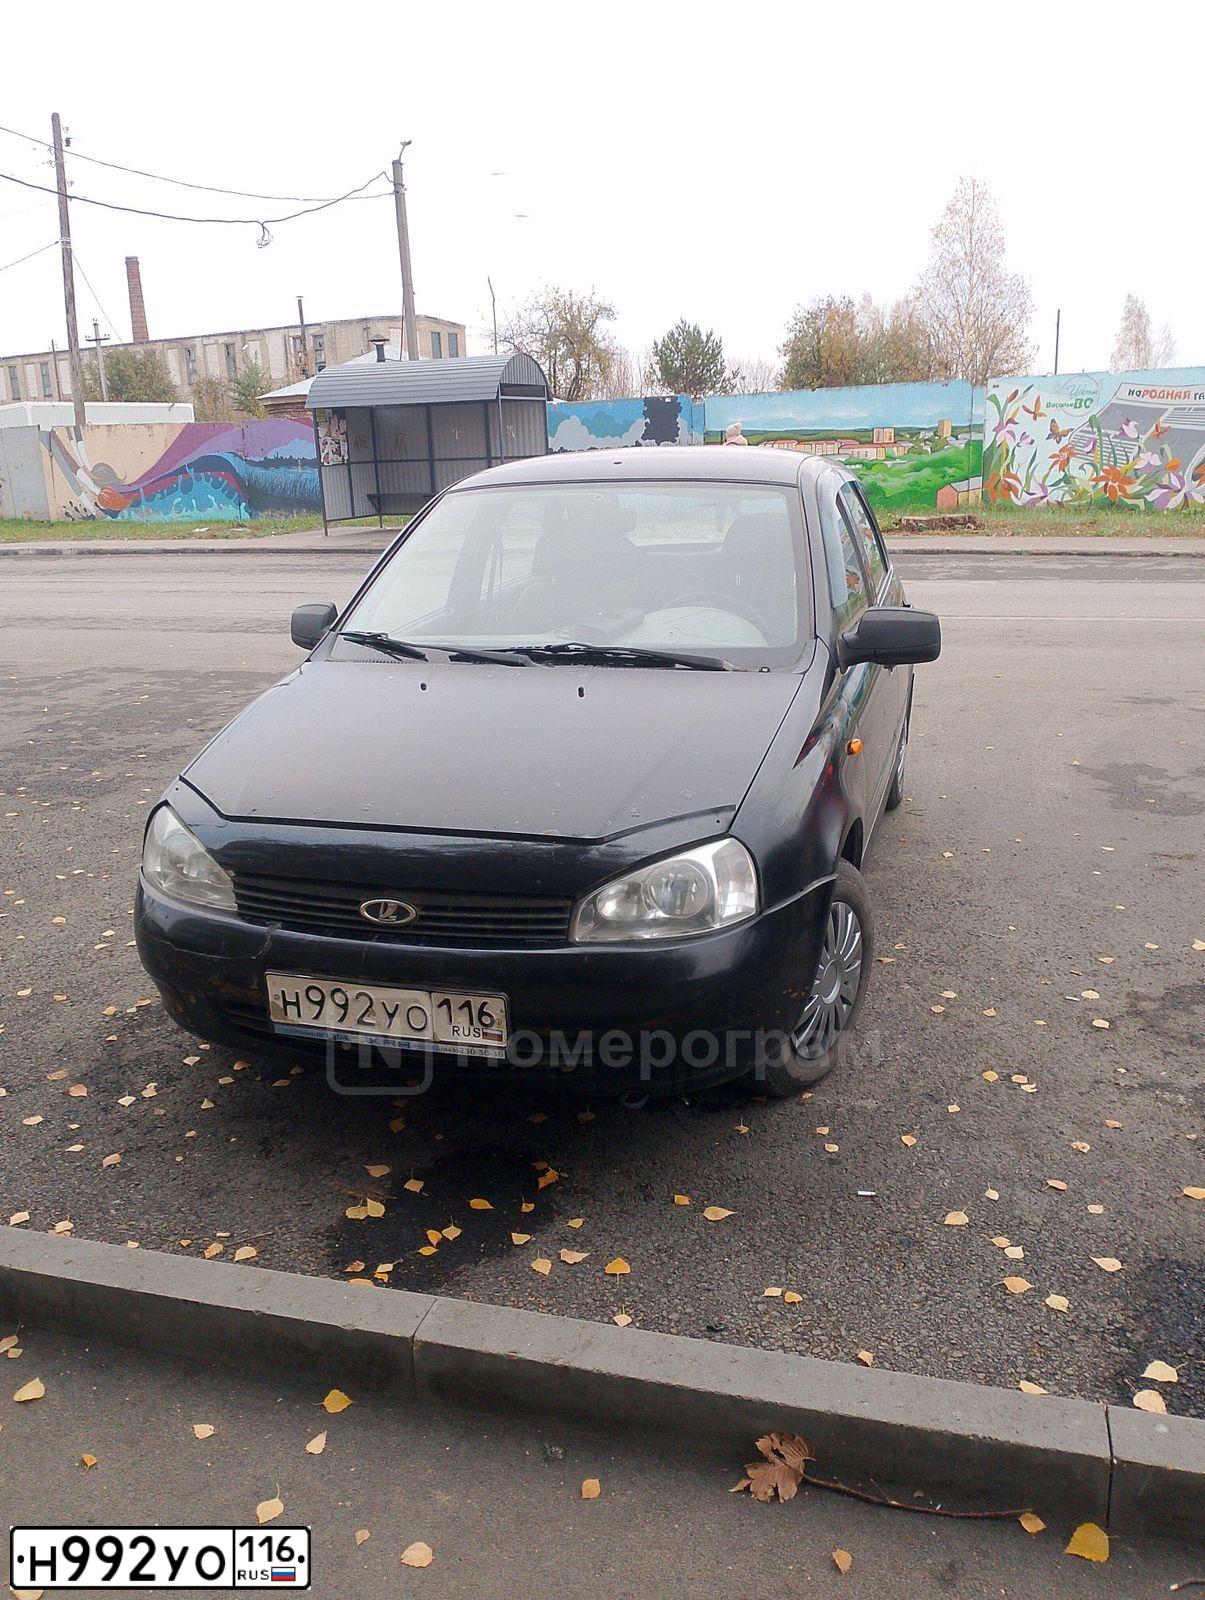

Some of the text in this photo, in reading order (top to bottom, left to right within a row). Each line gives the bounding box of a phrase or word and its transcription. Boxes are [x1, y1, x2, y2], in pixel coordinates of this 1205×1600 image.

[280, 985, 496, 1032] Н992УО 116
[452, 1025, 481, 1038] RUS
